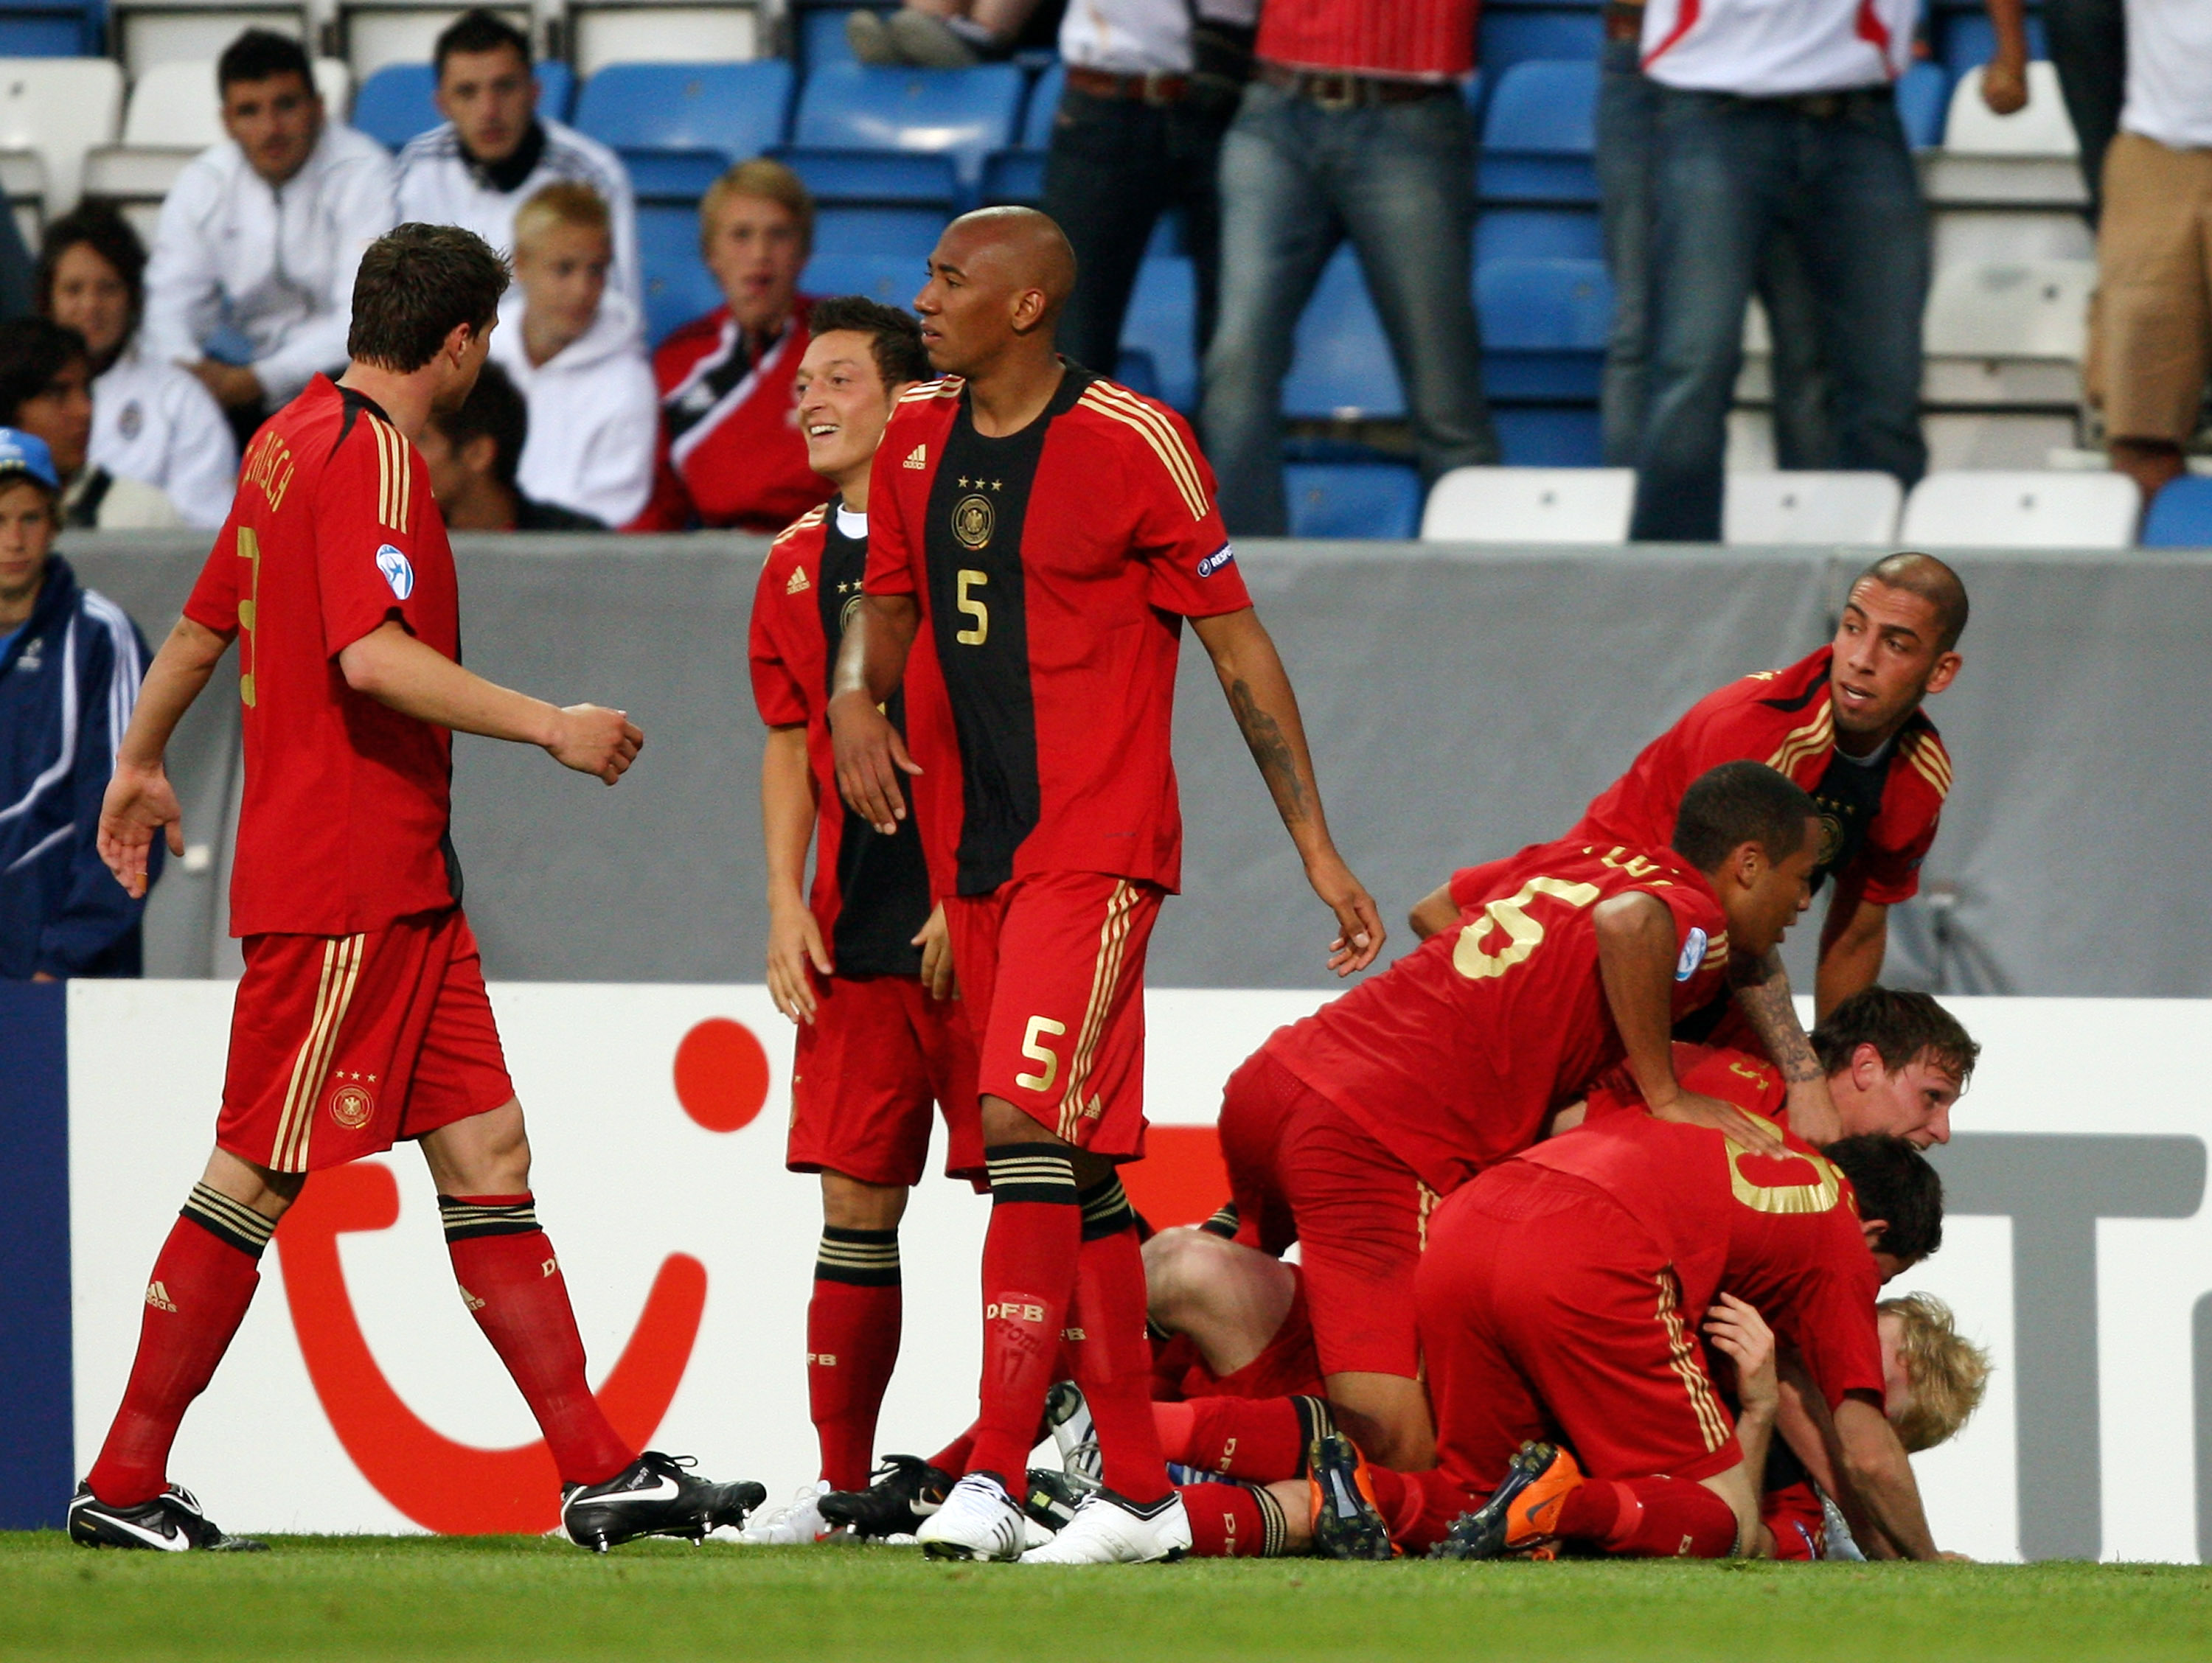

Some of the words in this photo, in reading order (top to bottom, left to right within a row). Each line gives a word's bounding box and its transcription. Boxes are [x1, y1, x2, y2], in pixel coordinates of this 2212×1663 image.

[956, 568, 988, 646] 5
[1453, 876, 1600, 979] 6
[1015, 1015, 1066, 1092] 5
[987, 1302, 1044, 1322] DFB
[807, 1353, 837, 1366] FB
[1215, 1437, 1237, 1474] DF
